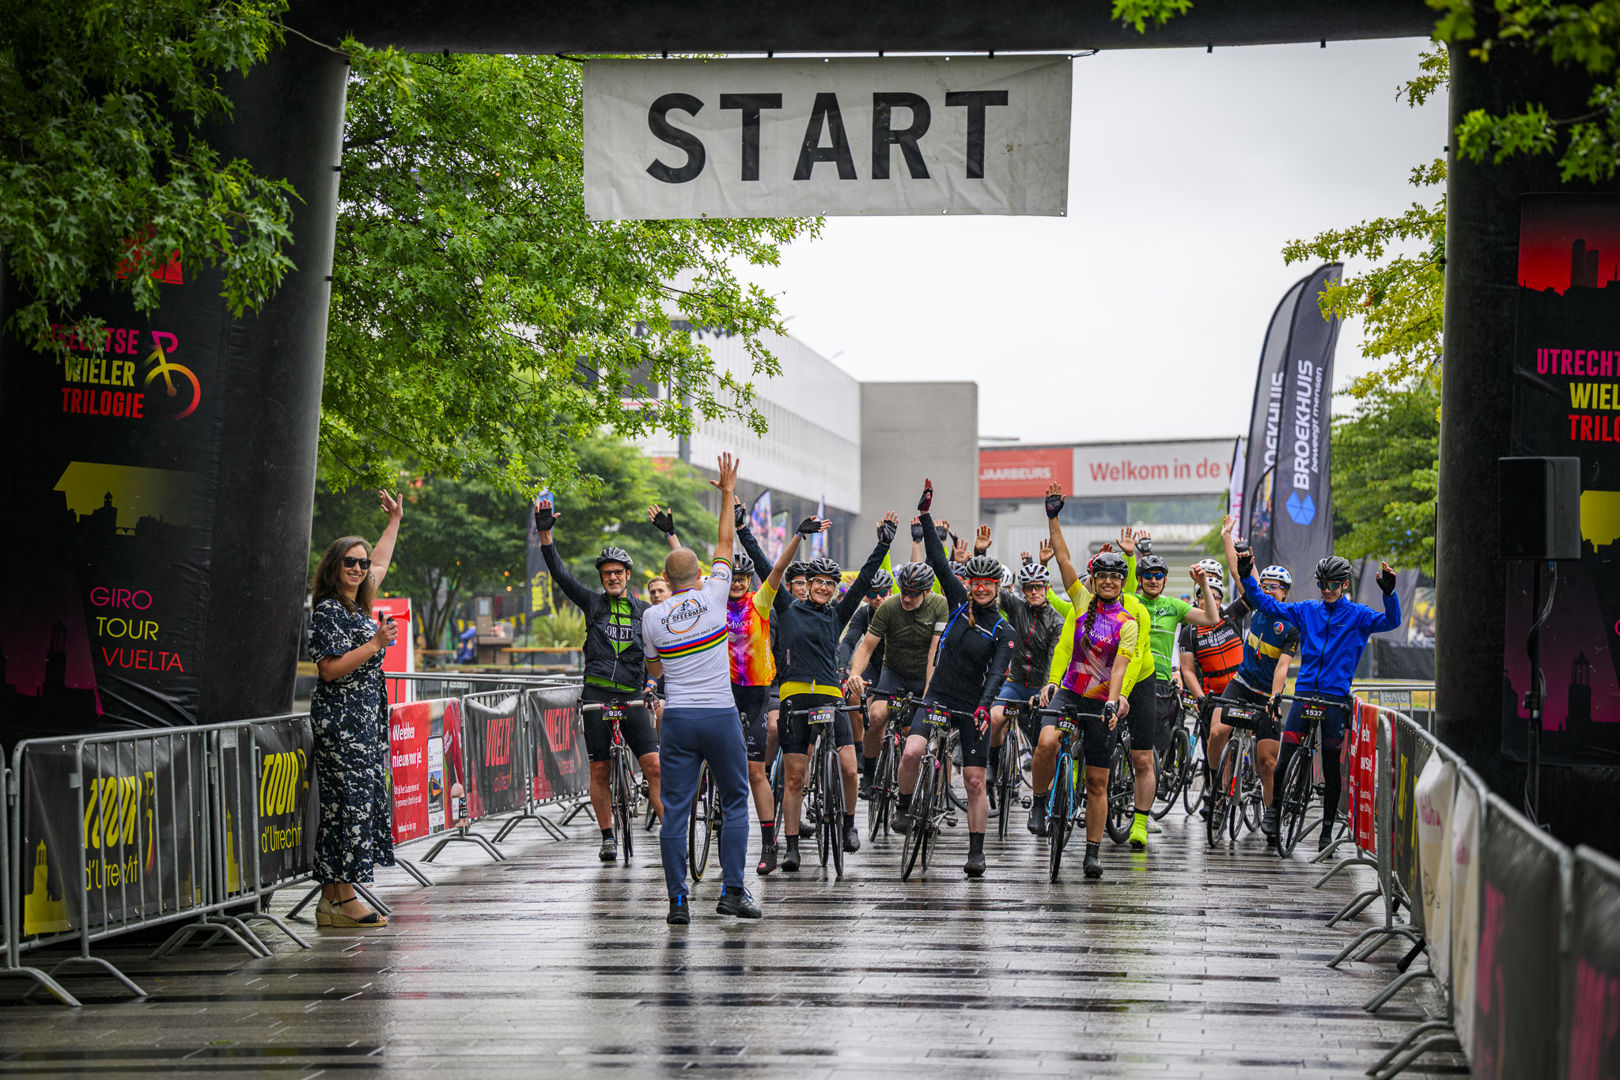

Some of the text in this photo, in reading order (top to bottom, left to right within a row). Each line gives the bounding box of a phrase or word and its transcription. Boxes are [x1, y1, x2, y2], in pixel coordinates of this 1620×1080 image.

[646, 90, 1009, 184] START
[64, 356, 136, 387] WIELER
[62, 387, 145, 419] TRILOGIE
[1569, 382, 1620, 410] WIEL
[1293, 359, 1313, 490] BROEKHUIS
[1090, 461, 1168, 481] Welkom
[1173, 458, 1190, 479] in
[1196, 457, 1220, 478] de
[90, 586, 153, 610] GIRO
[96, 616, 159, 641] TOUR
[102, 646, 184, 673] VUELTA
[1305, 709, 1323, 717] 1537
[544, 707, 570, 753] VUELTA
[260, 751, 299, 818] TOUR
[261, 820, 302, 854] d'Utrecht
